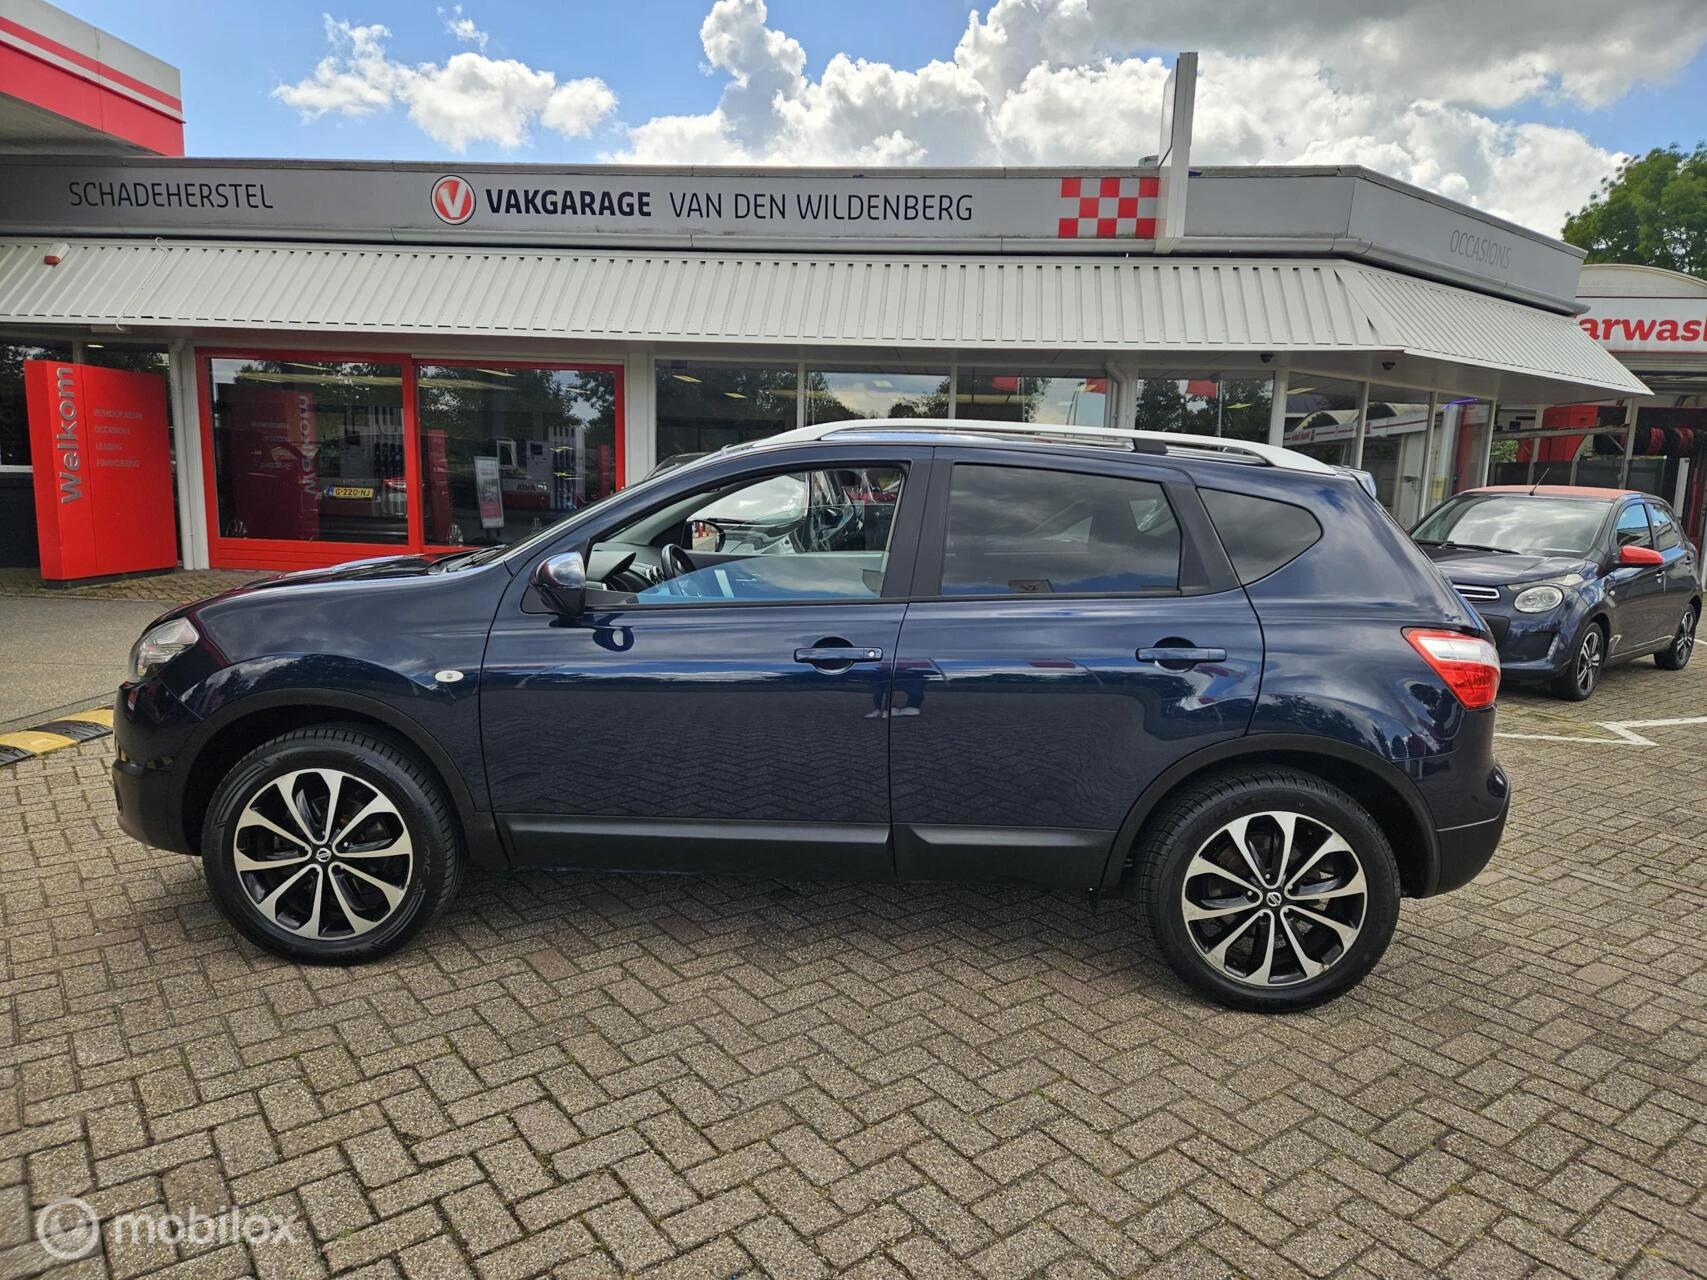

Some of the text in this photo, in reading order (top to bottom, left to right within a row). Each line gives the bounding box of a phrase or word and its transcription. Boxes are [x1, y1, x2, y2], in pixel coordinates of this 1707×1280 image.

[68, 182, 274, 209] SCHADEHERSTEL
[485, 188, 973, 221] VAKGARAGE VAN DEN WILDENBERG
[1450, 229, 1513, 270] OCCASIONS
[1574, 312, 1707, 342] arwas
[56, 367, 83, 504] Welkom
